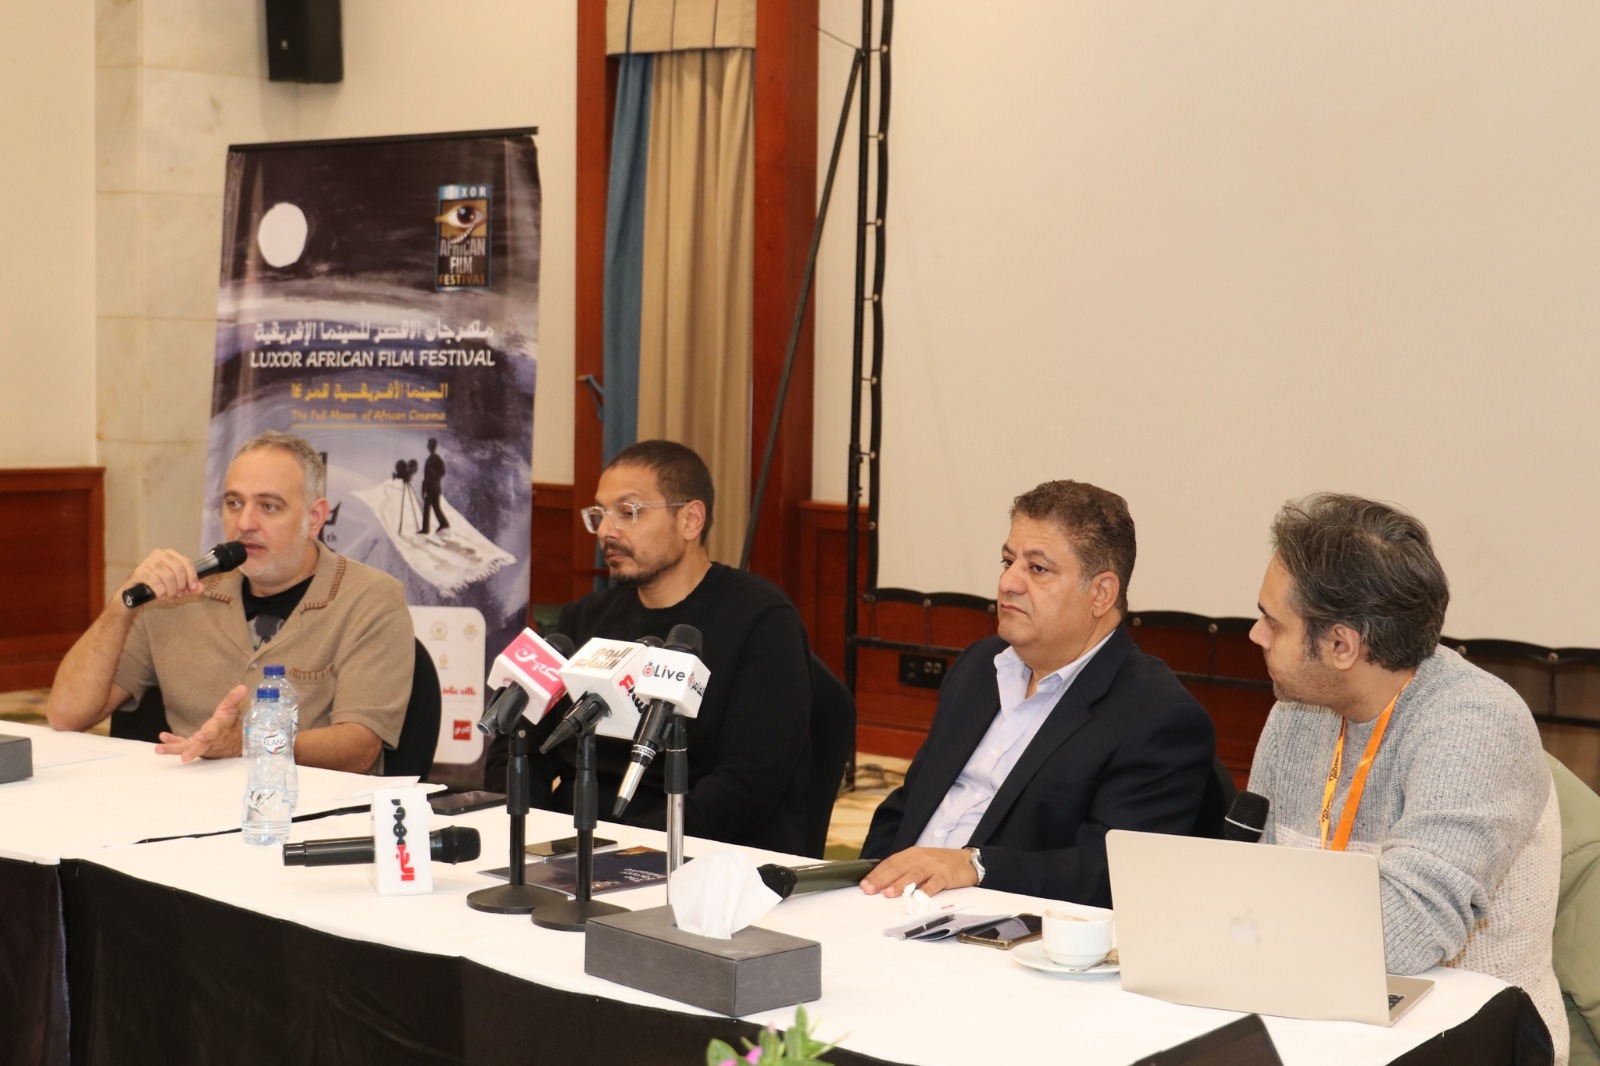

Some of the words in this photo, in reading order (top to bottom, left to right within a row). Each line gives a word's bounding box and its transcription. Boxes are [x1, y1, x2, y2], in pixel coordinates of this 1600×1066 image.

[445, 187, 486, 199] XOR
[440, 238, 486, 256] AFRICAN
[450, 256, 473, 274] FILM
[439, 273, 486, 286] FESTIVAL
[321, 320, 370, 344] للسينما
[425, 319, 494, 345] مهرجان
[250, 351, 302, 368] LUXOR
[306, 351, 374, 368] AFRICAN
[378, 350, 415, 367] FILM
[419, 349, 496, 367] FESTIVAL
[292, 409, 308, 420] The
[362, 408, 373, 422] of
[374, 409, 406, 422] African
[409, 408, 446, 421] Cinema
[654, 664, 686, 682] Live
